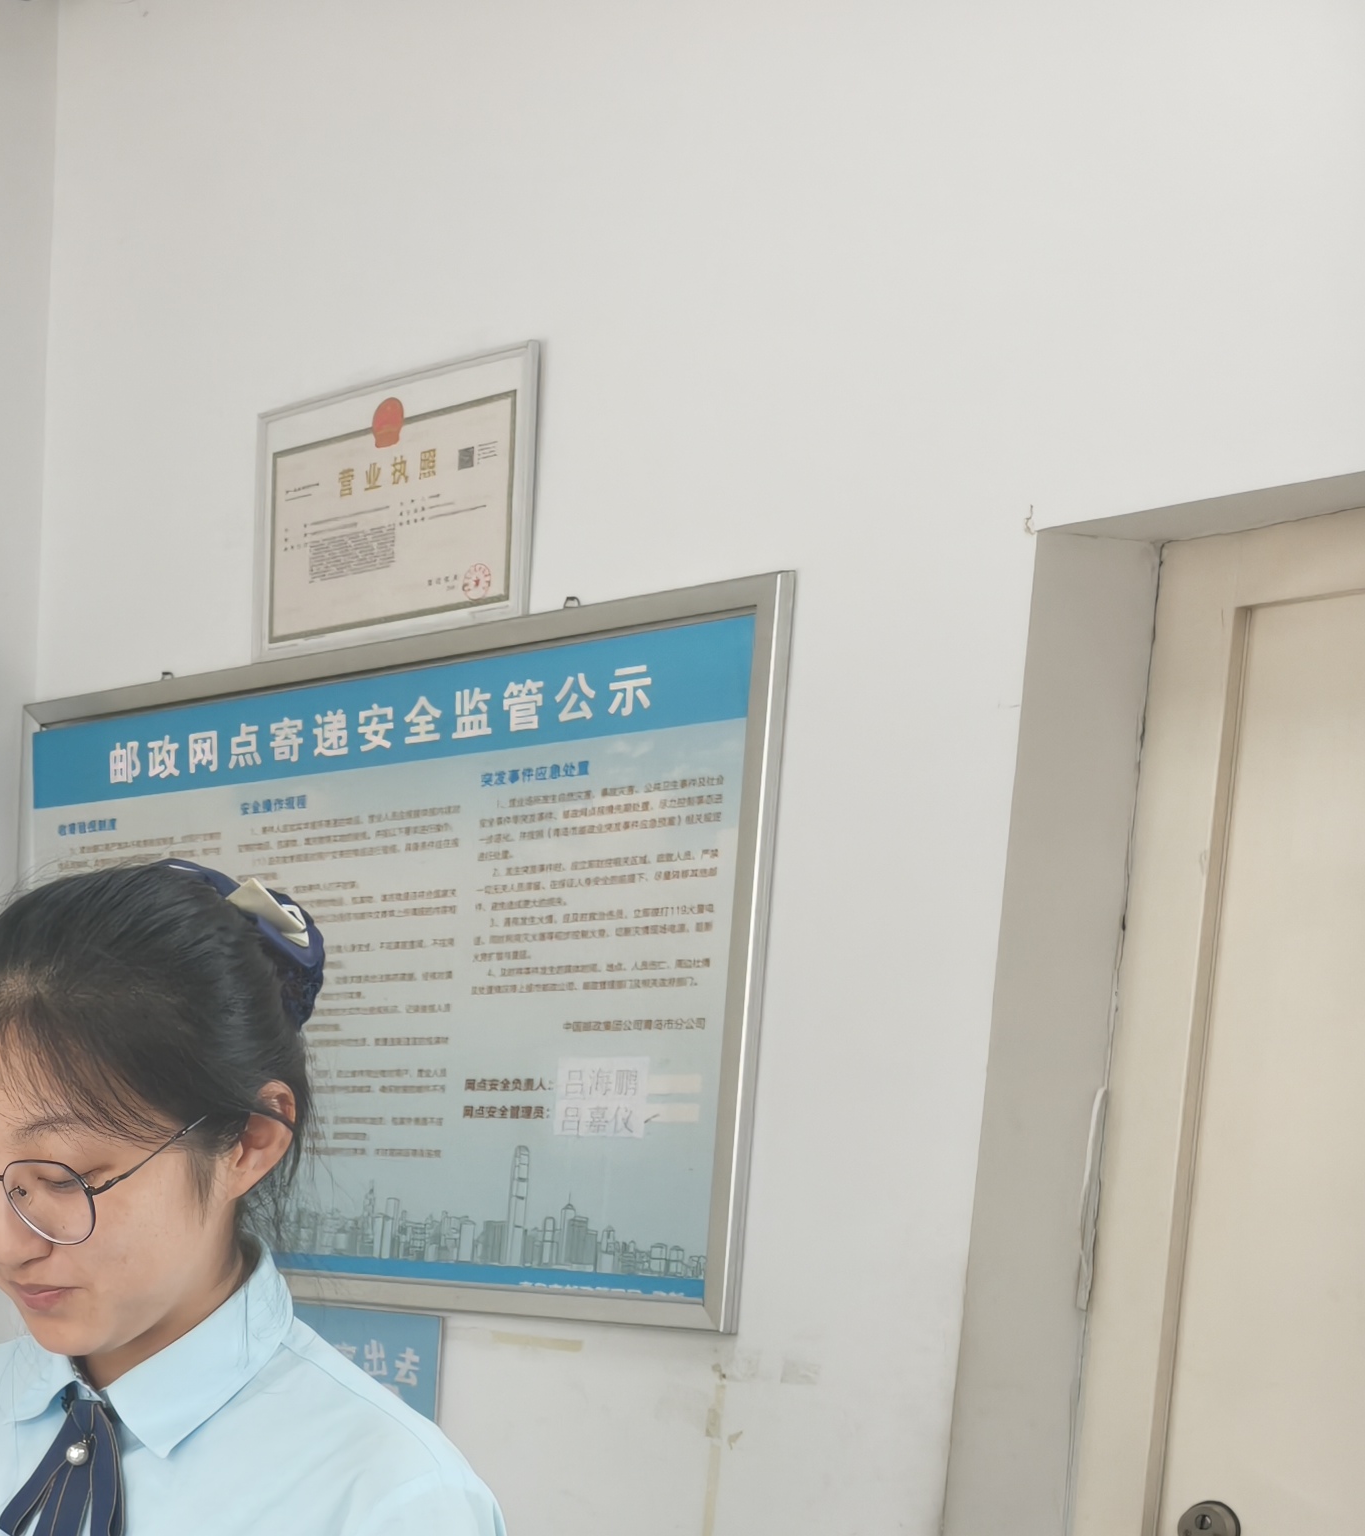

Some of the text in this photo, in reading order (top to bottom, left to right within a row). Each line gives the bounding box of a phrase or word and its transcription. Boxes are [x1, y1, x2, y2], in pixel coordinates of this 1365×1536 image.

[338, 448, 437, 498] 营业执照
[108, 664, 653, 785] 邮政网点寄递安全监管公示
[480, 759, 591, 788] 突发事件应急处置
